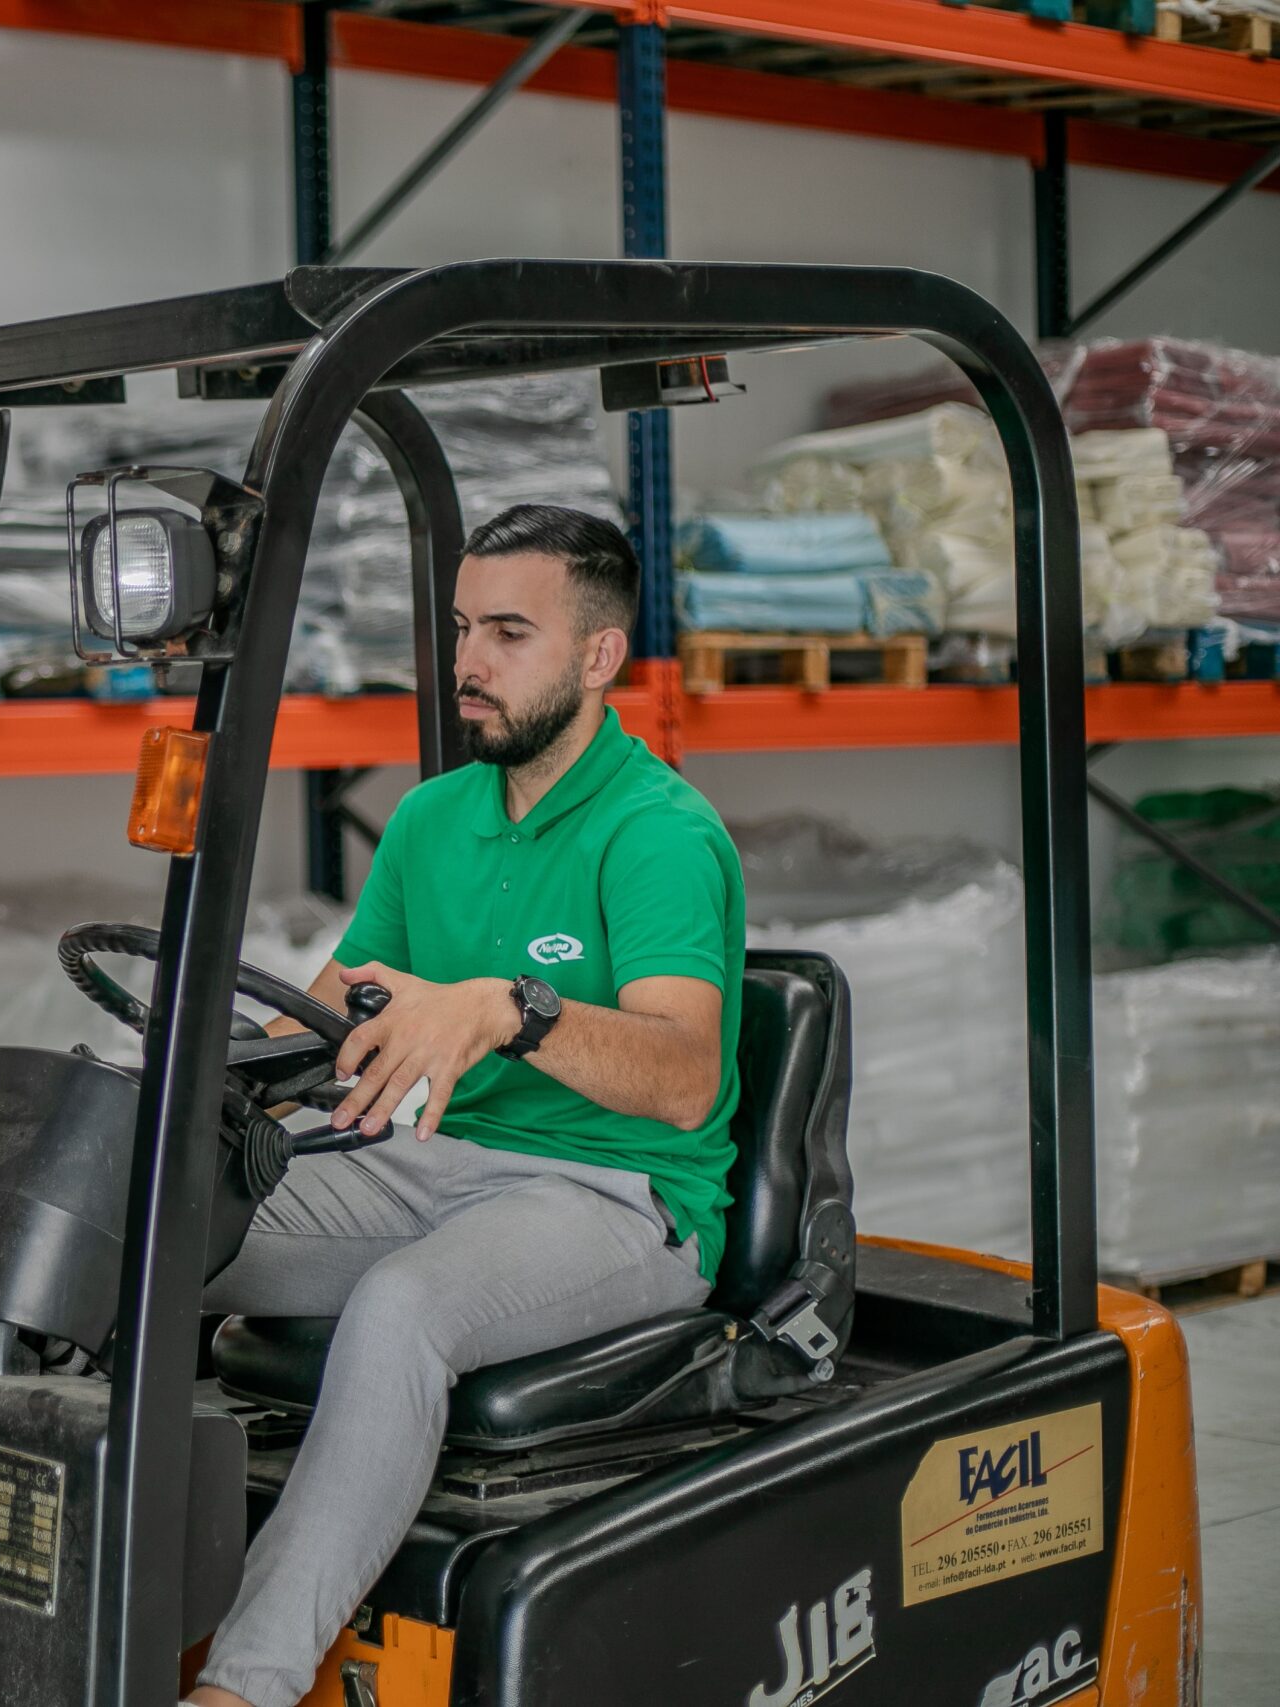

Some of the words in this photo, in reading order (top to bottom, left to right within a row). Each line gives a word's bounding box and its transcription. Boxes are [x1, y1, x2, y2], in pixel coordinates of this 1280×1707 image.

[958, 1430, 1047, 1506] FACIL
[912, 1561, 935, 1577] TEL.
[938, 1552, 957, 1570] 296
[961, 1541, 999, 1564] 205550
[1008, 1536, 1030, 1552] FAX.
[1033, 1527, 1052, 1545] 296
[1055, 1517, 1091, 1539] 205551
[943, 1560, 1006, 1584] info@facil-lda.pt
[1040, 1539, 1086, 1559] www.facil.pt
